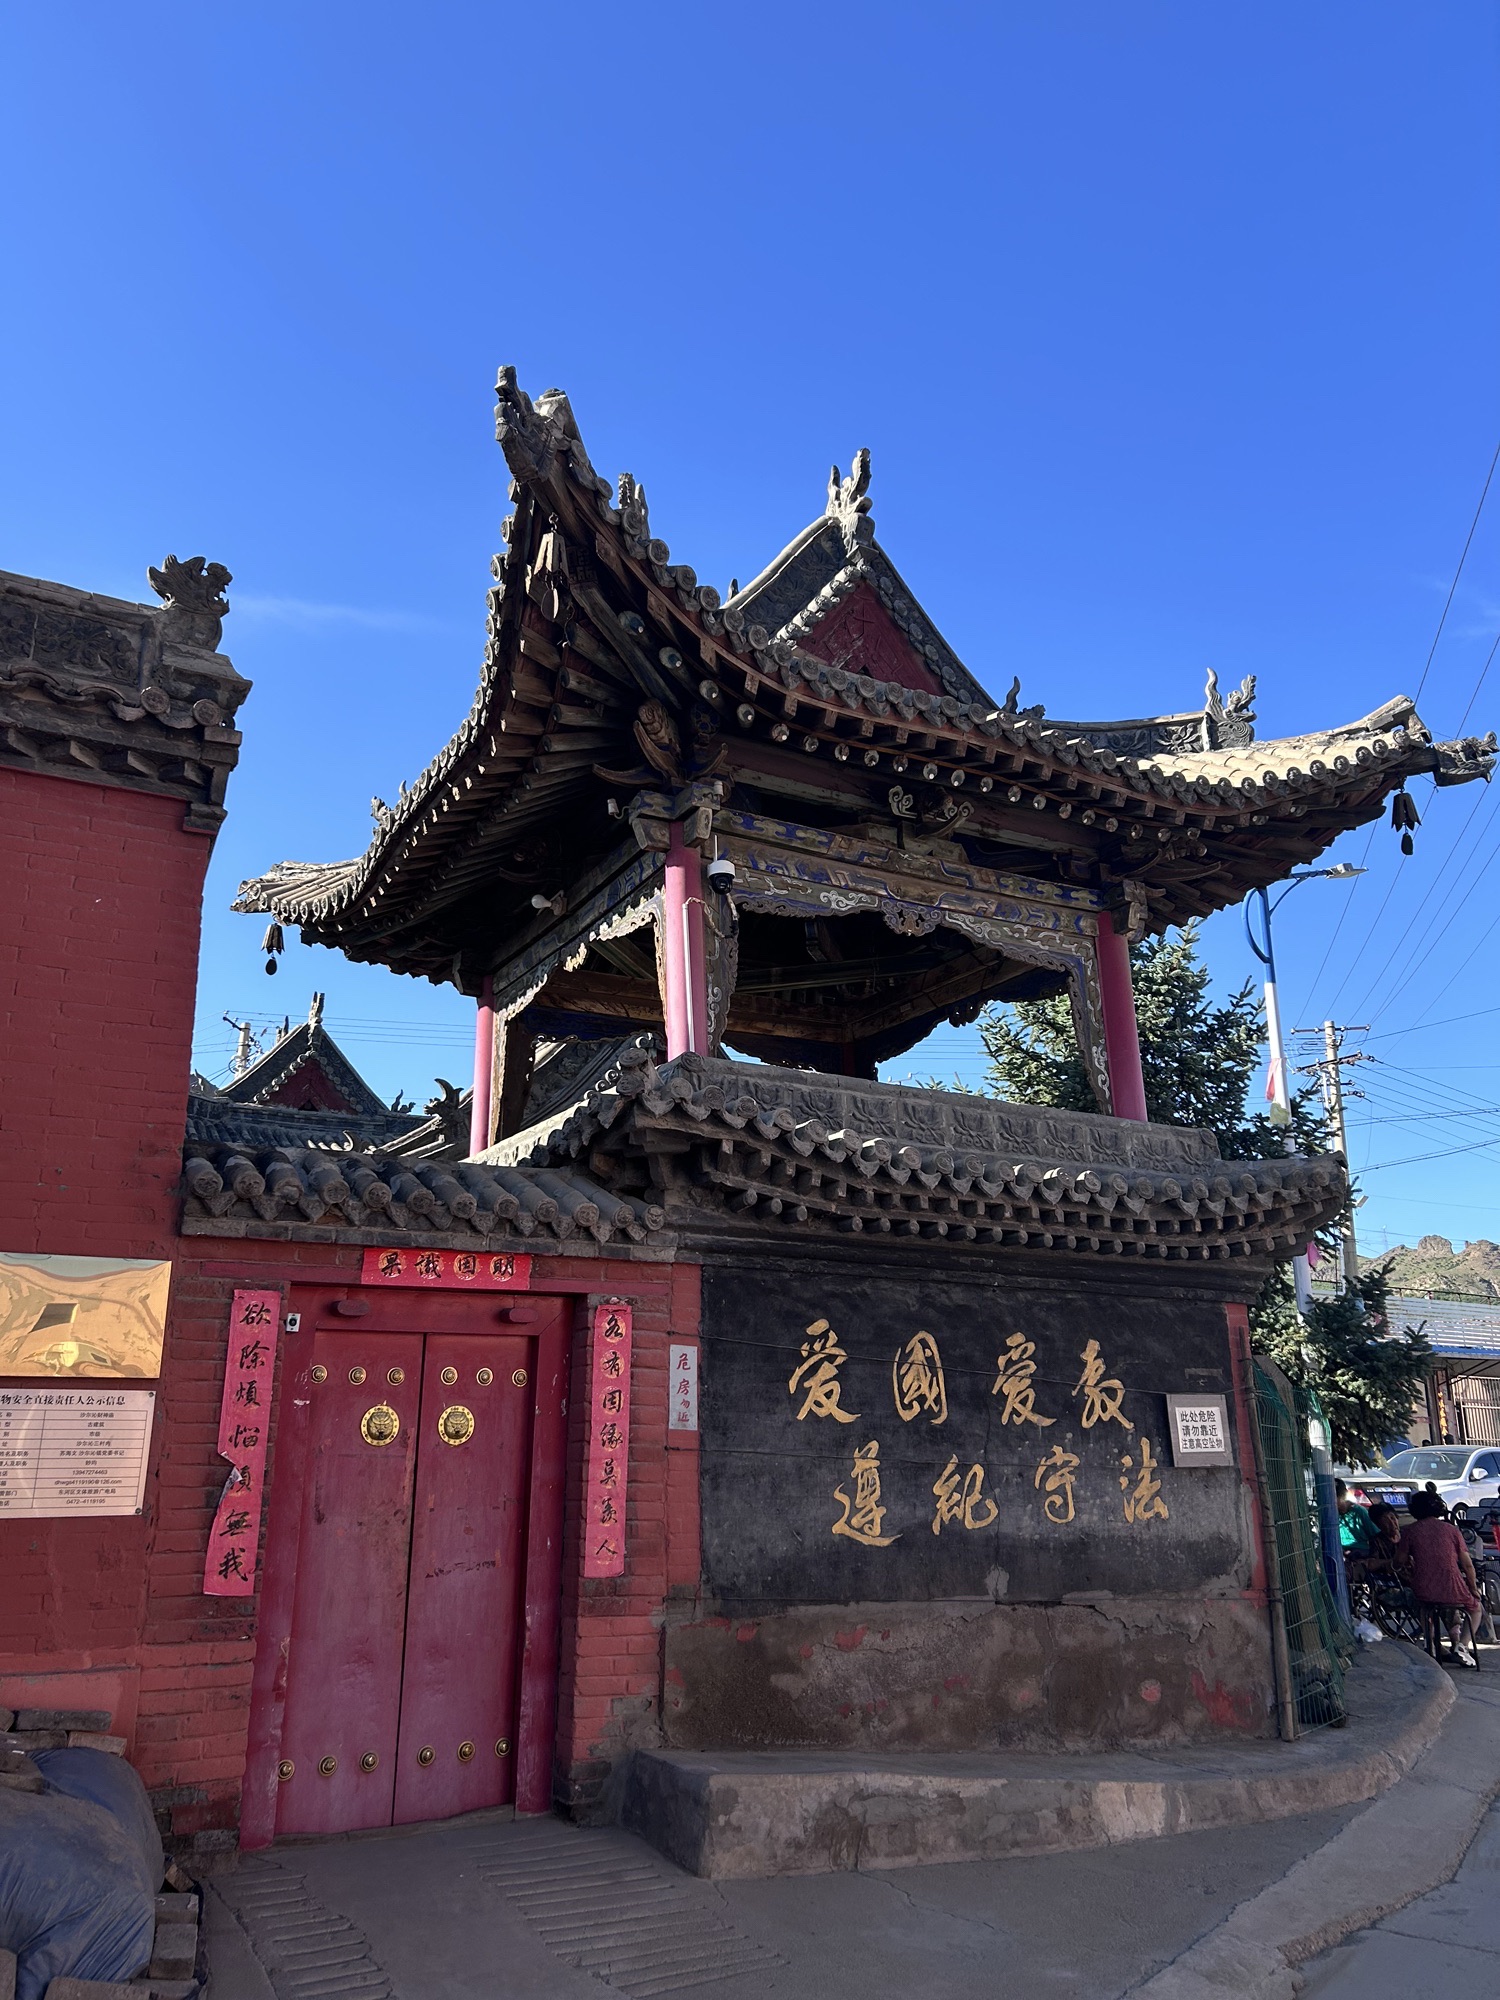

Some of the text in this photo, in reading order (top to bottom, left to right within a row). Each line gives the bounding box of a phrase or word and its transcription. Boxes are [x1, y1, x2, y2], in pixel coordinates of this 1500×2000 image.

[0, 1394, 126, 1406] 物安全直接责任人公示信息
[1180, 1410, 1217, 1423] 此处危险
[1181, 1424, 1219, 1437] 请勿靠近
[1181, 1437, 1223, 1450] 注意高空坠物
